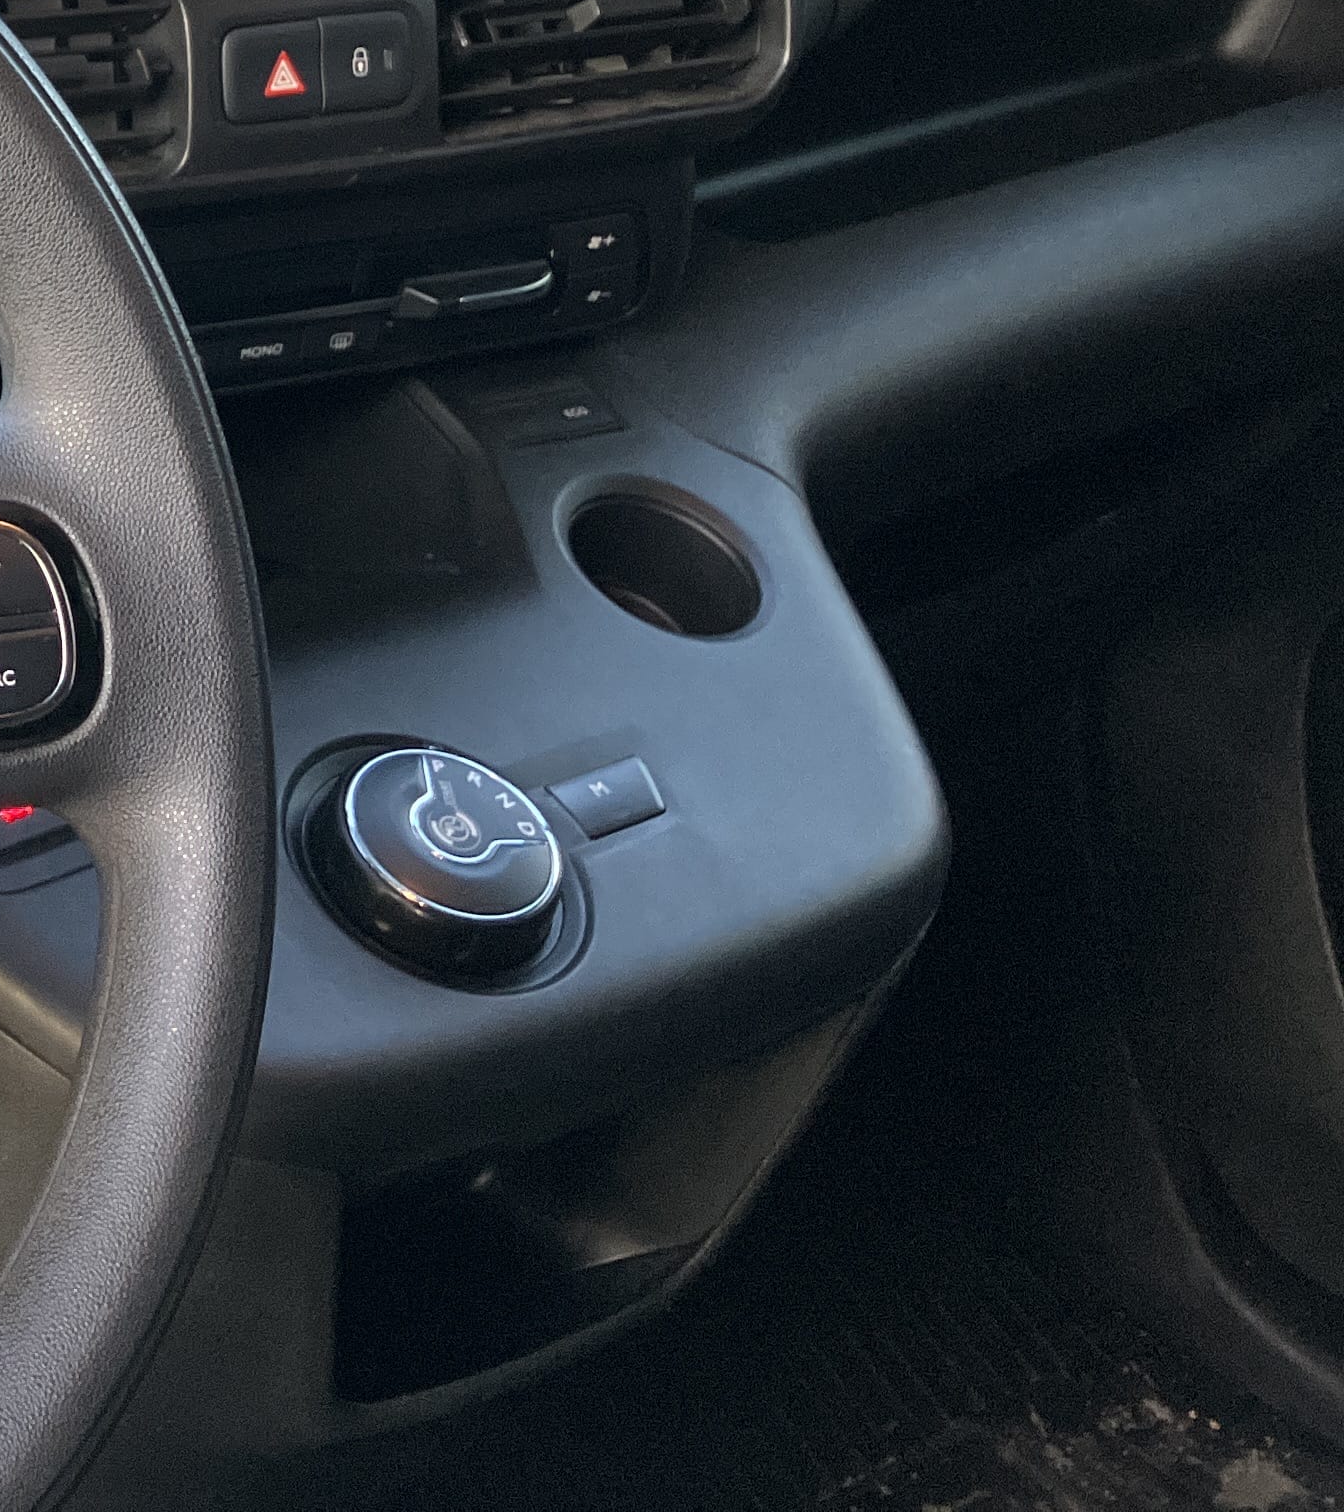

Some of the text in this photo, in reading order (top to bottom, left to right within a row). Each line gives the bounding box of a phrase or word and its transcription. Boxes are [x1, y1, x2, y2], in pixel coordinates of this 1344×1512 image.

[239, 342, 285, 361] MONO
[431, 759, 446, 773] P
[466, 770, 482, 789] R
[587, 780, 612, 799] M
[494, 791, 516, 810] N
[516, 820, 536, 837] D
